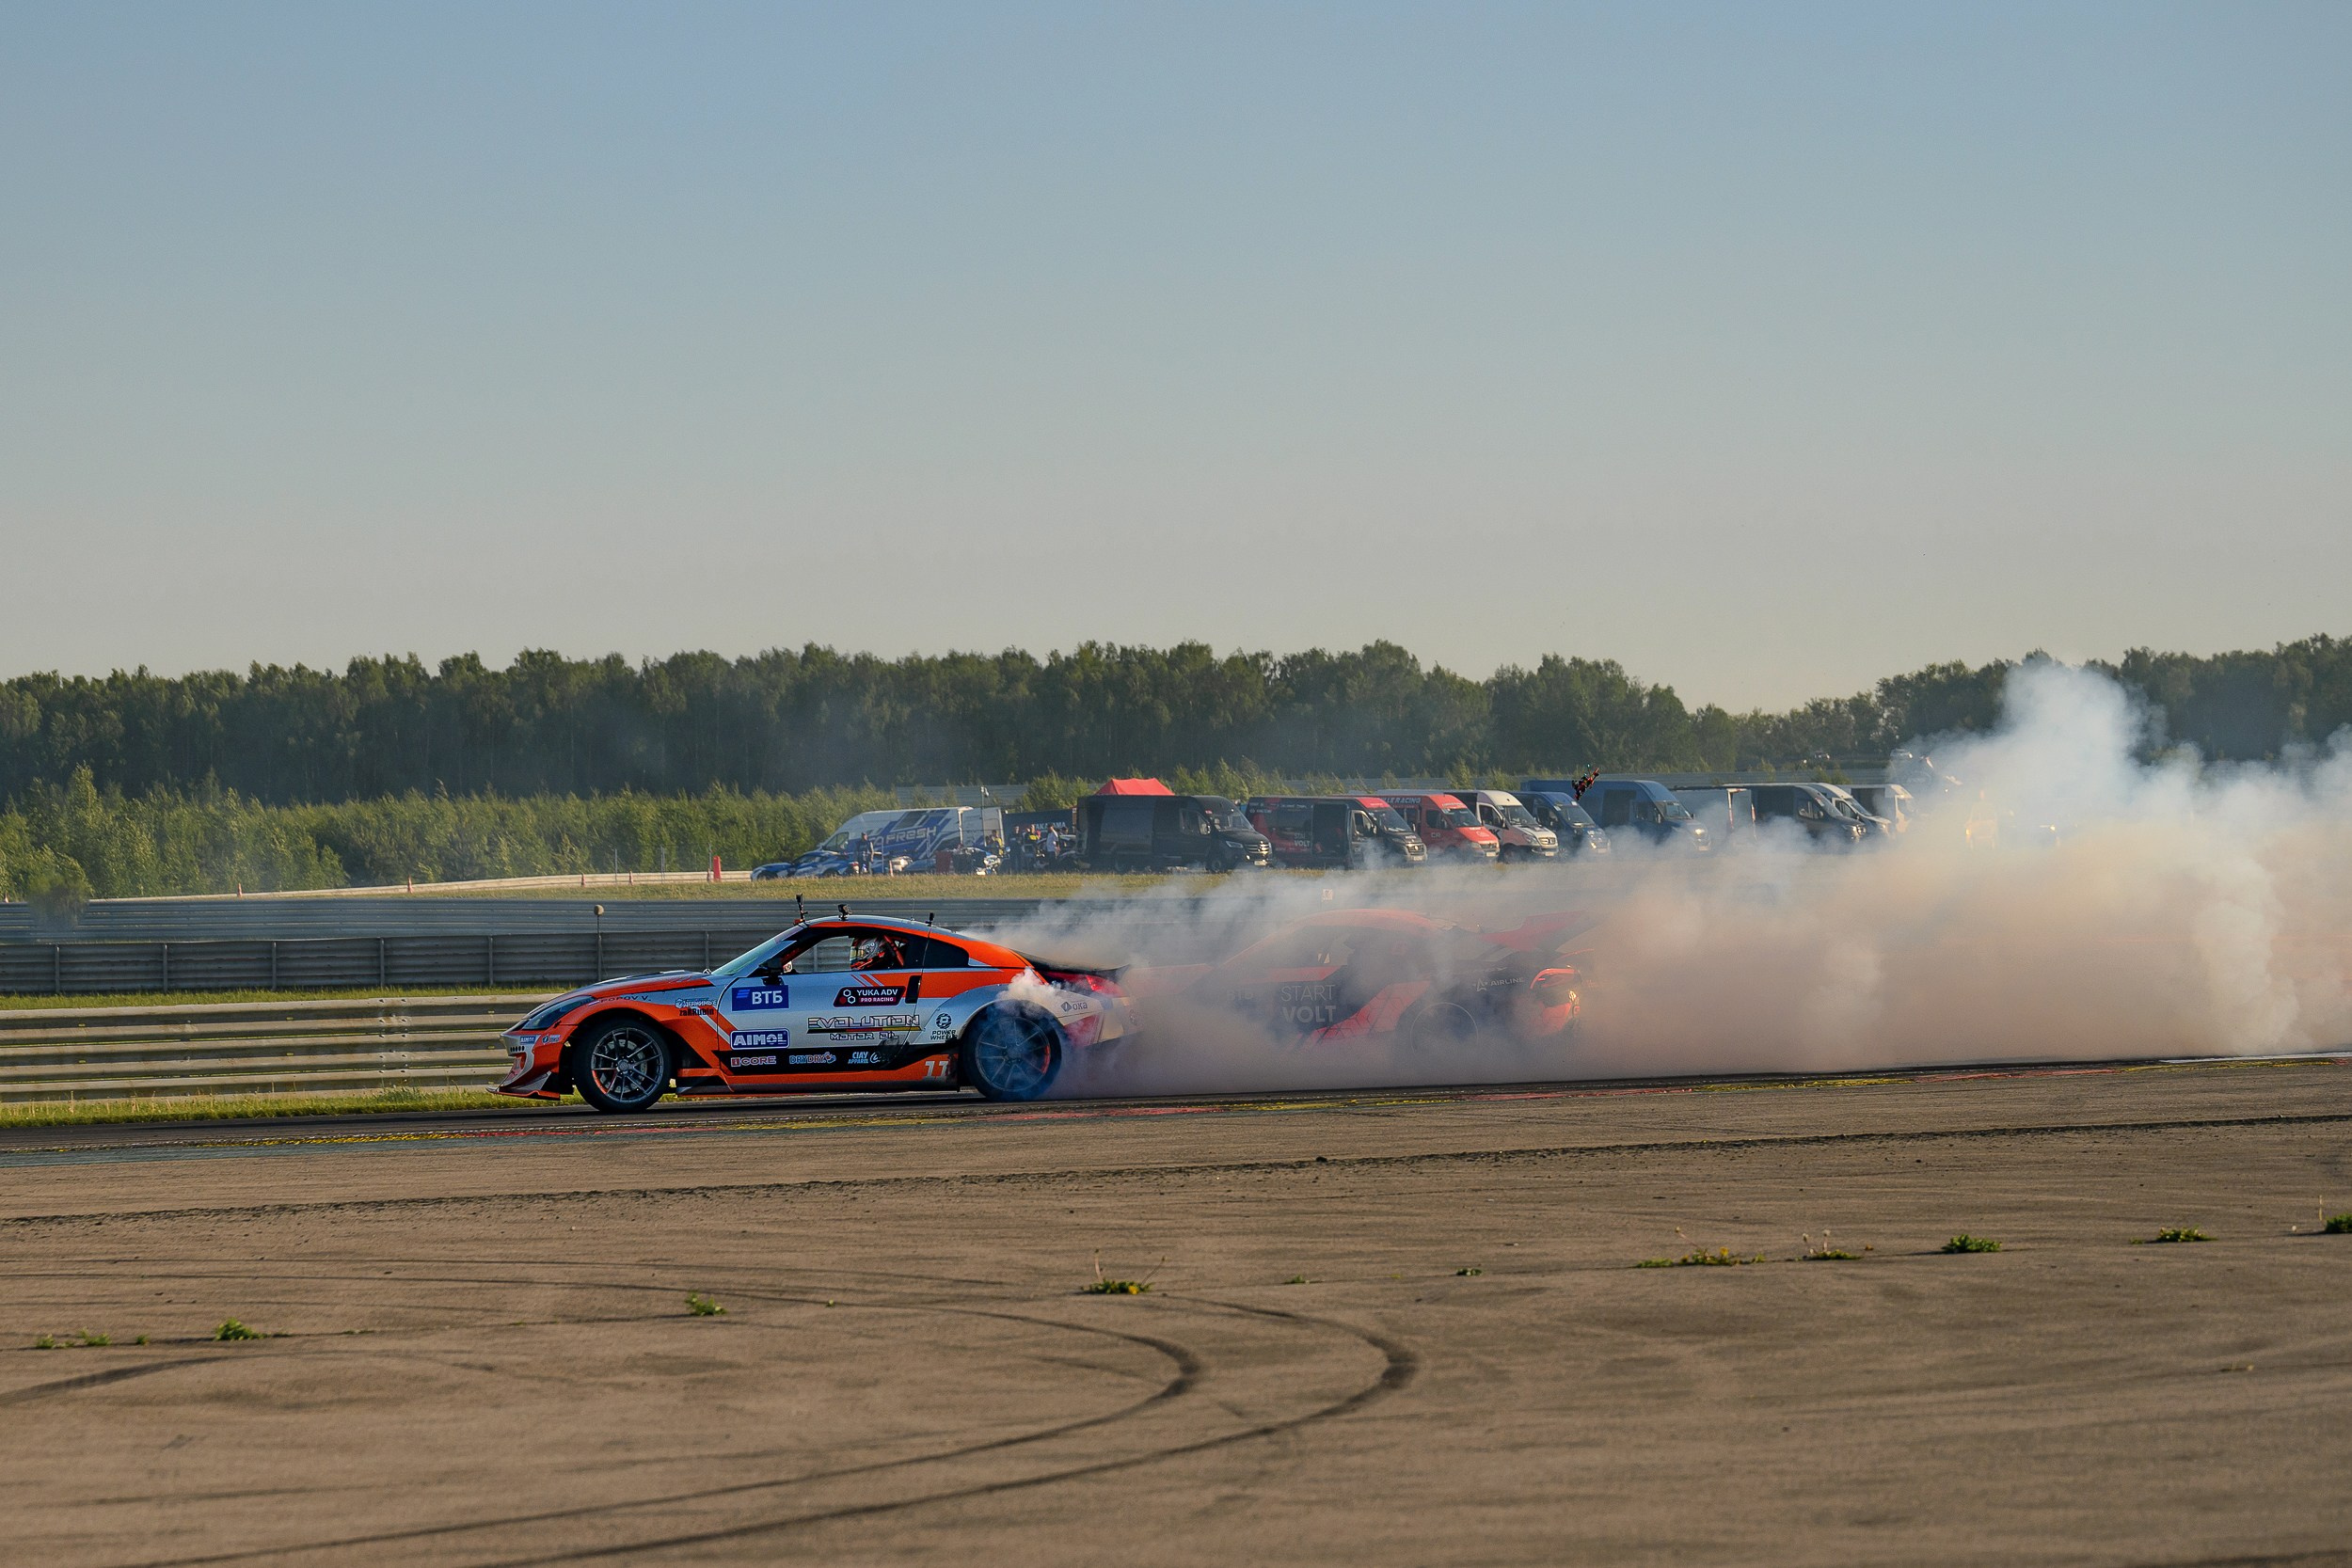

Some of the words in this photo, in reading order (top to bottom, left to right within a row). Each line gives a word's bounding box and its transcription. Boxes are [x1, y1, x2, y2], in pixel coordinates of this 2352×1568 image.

[1490, 977, 1525, 988] AIRLINE
[1280, 984, 1336, 1002] START
[1282, 1006, 1337, 1023] VOLT
[807, 1015, 920, 1029] EVOLUTION
[733, 1033, 787, 1046] AIMOL
[830, 1032, 874, 1041] MOTOR
